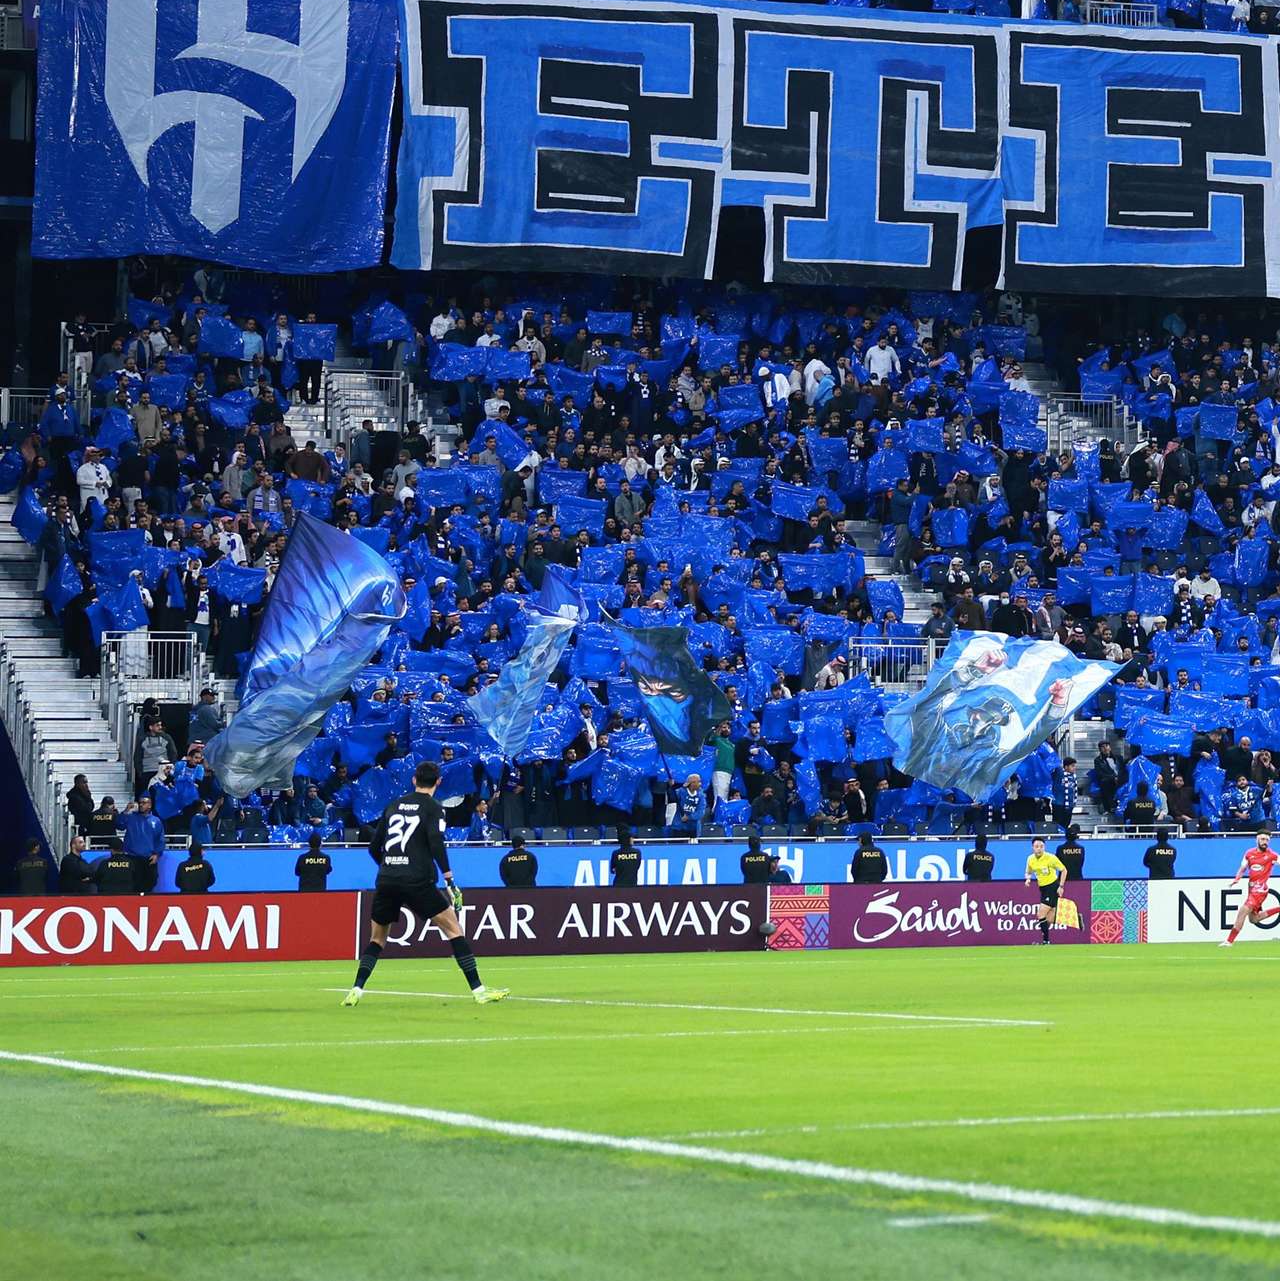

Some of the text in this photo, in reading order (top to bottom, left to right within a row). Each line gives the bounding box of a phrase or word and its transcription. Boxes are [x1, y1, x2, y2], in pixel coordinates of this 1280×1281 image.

[385, 813, 420, 853] 37
[305, 857, 327, 865] POLICE
[617, 853, 637, 861] POLICE
[745, 855, 765, 863] POLICE
[973, 854, 993, 862] POLICE
[108, 861, 129, 869] POLICE
[557, 899, 752, 938] AIRWAYS
[853, 888, 983, 943] Saudi
[997, 917, 1012, 930] to
[0, 905, 281, 955] KONAMI
